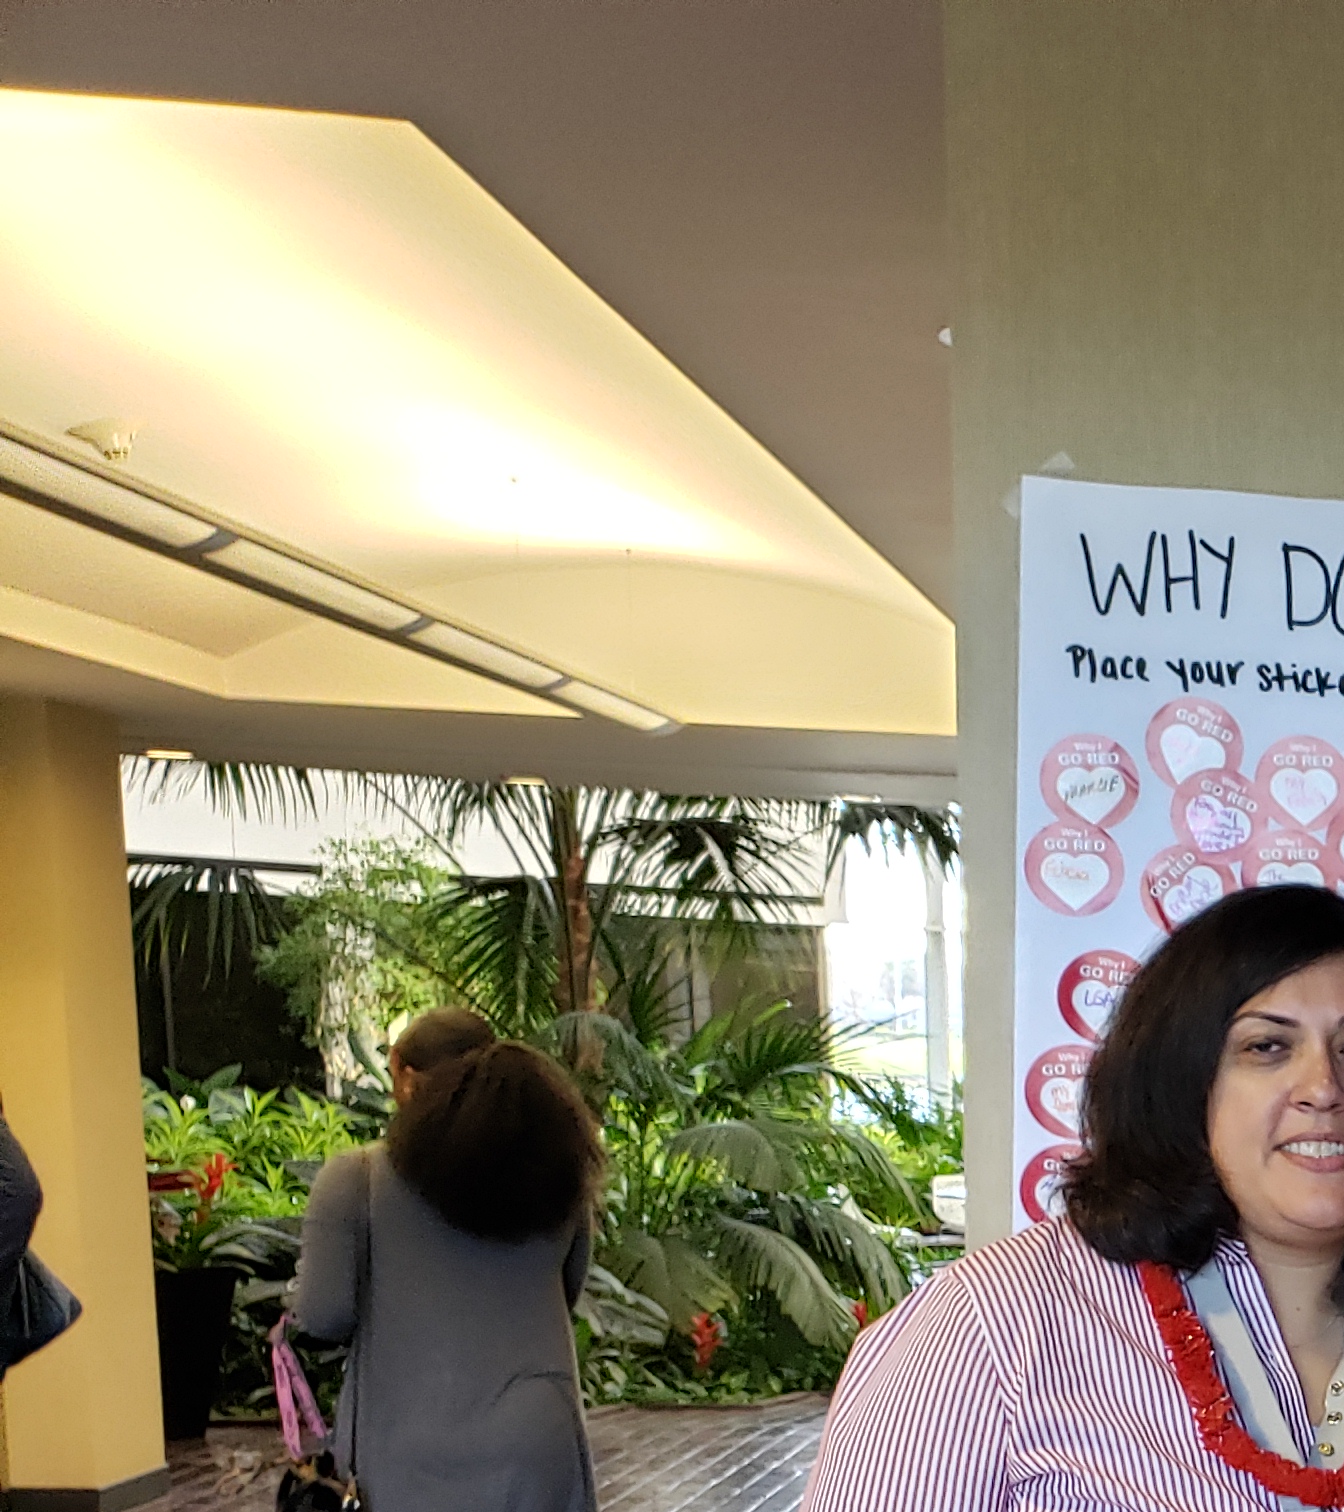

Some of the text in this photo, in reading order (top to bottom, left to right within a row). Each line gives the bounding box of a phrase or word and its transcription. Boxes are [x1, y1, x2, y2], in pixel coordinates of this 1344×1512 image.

[1079, 529, 1235, 619] WHY
[1065, 644, 1150, 683] Place
[1165, 658, 1244, 692] your
